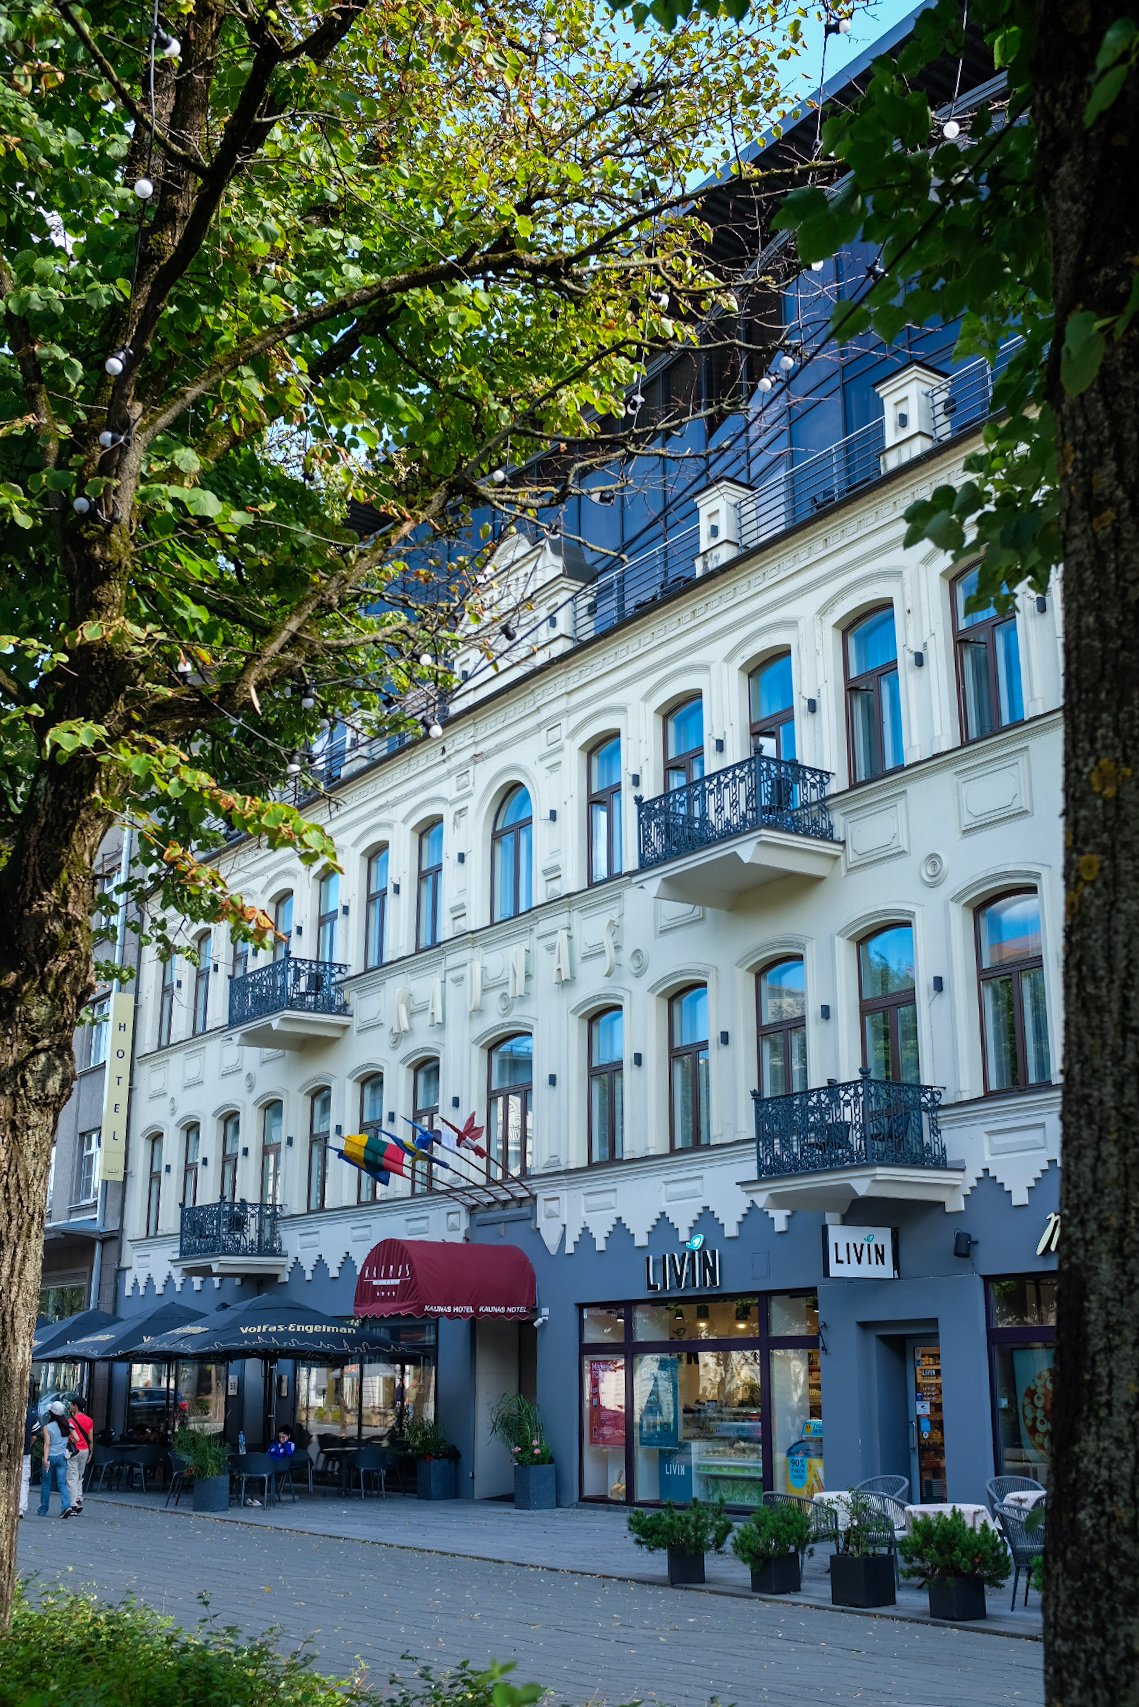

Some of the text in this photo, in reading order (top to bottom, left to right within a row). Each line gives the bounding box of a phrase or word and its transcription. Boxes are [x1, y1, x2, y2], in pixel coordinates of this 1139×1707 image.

[112, 1022, 126, 1141] HOTEL
[834, 1242, 885, 1266] LIVIN
[646, 1249, 719, 1292] LIVIN
[424, 1304, 452, 1313] KAUNAS
[453, 1305, 474, 1313] HOTEL
[479, 1305, 506, 1313] KAUNAS
[665, 1463, 685, 1475] LIVIN
